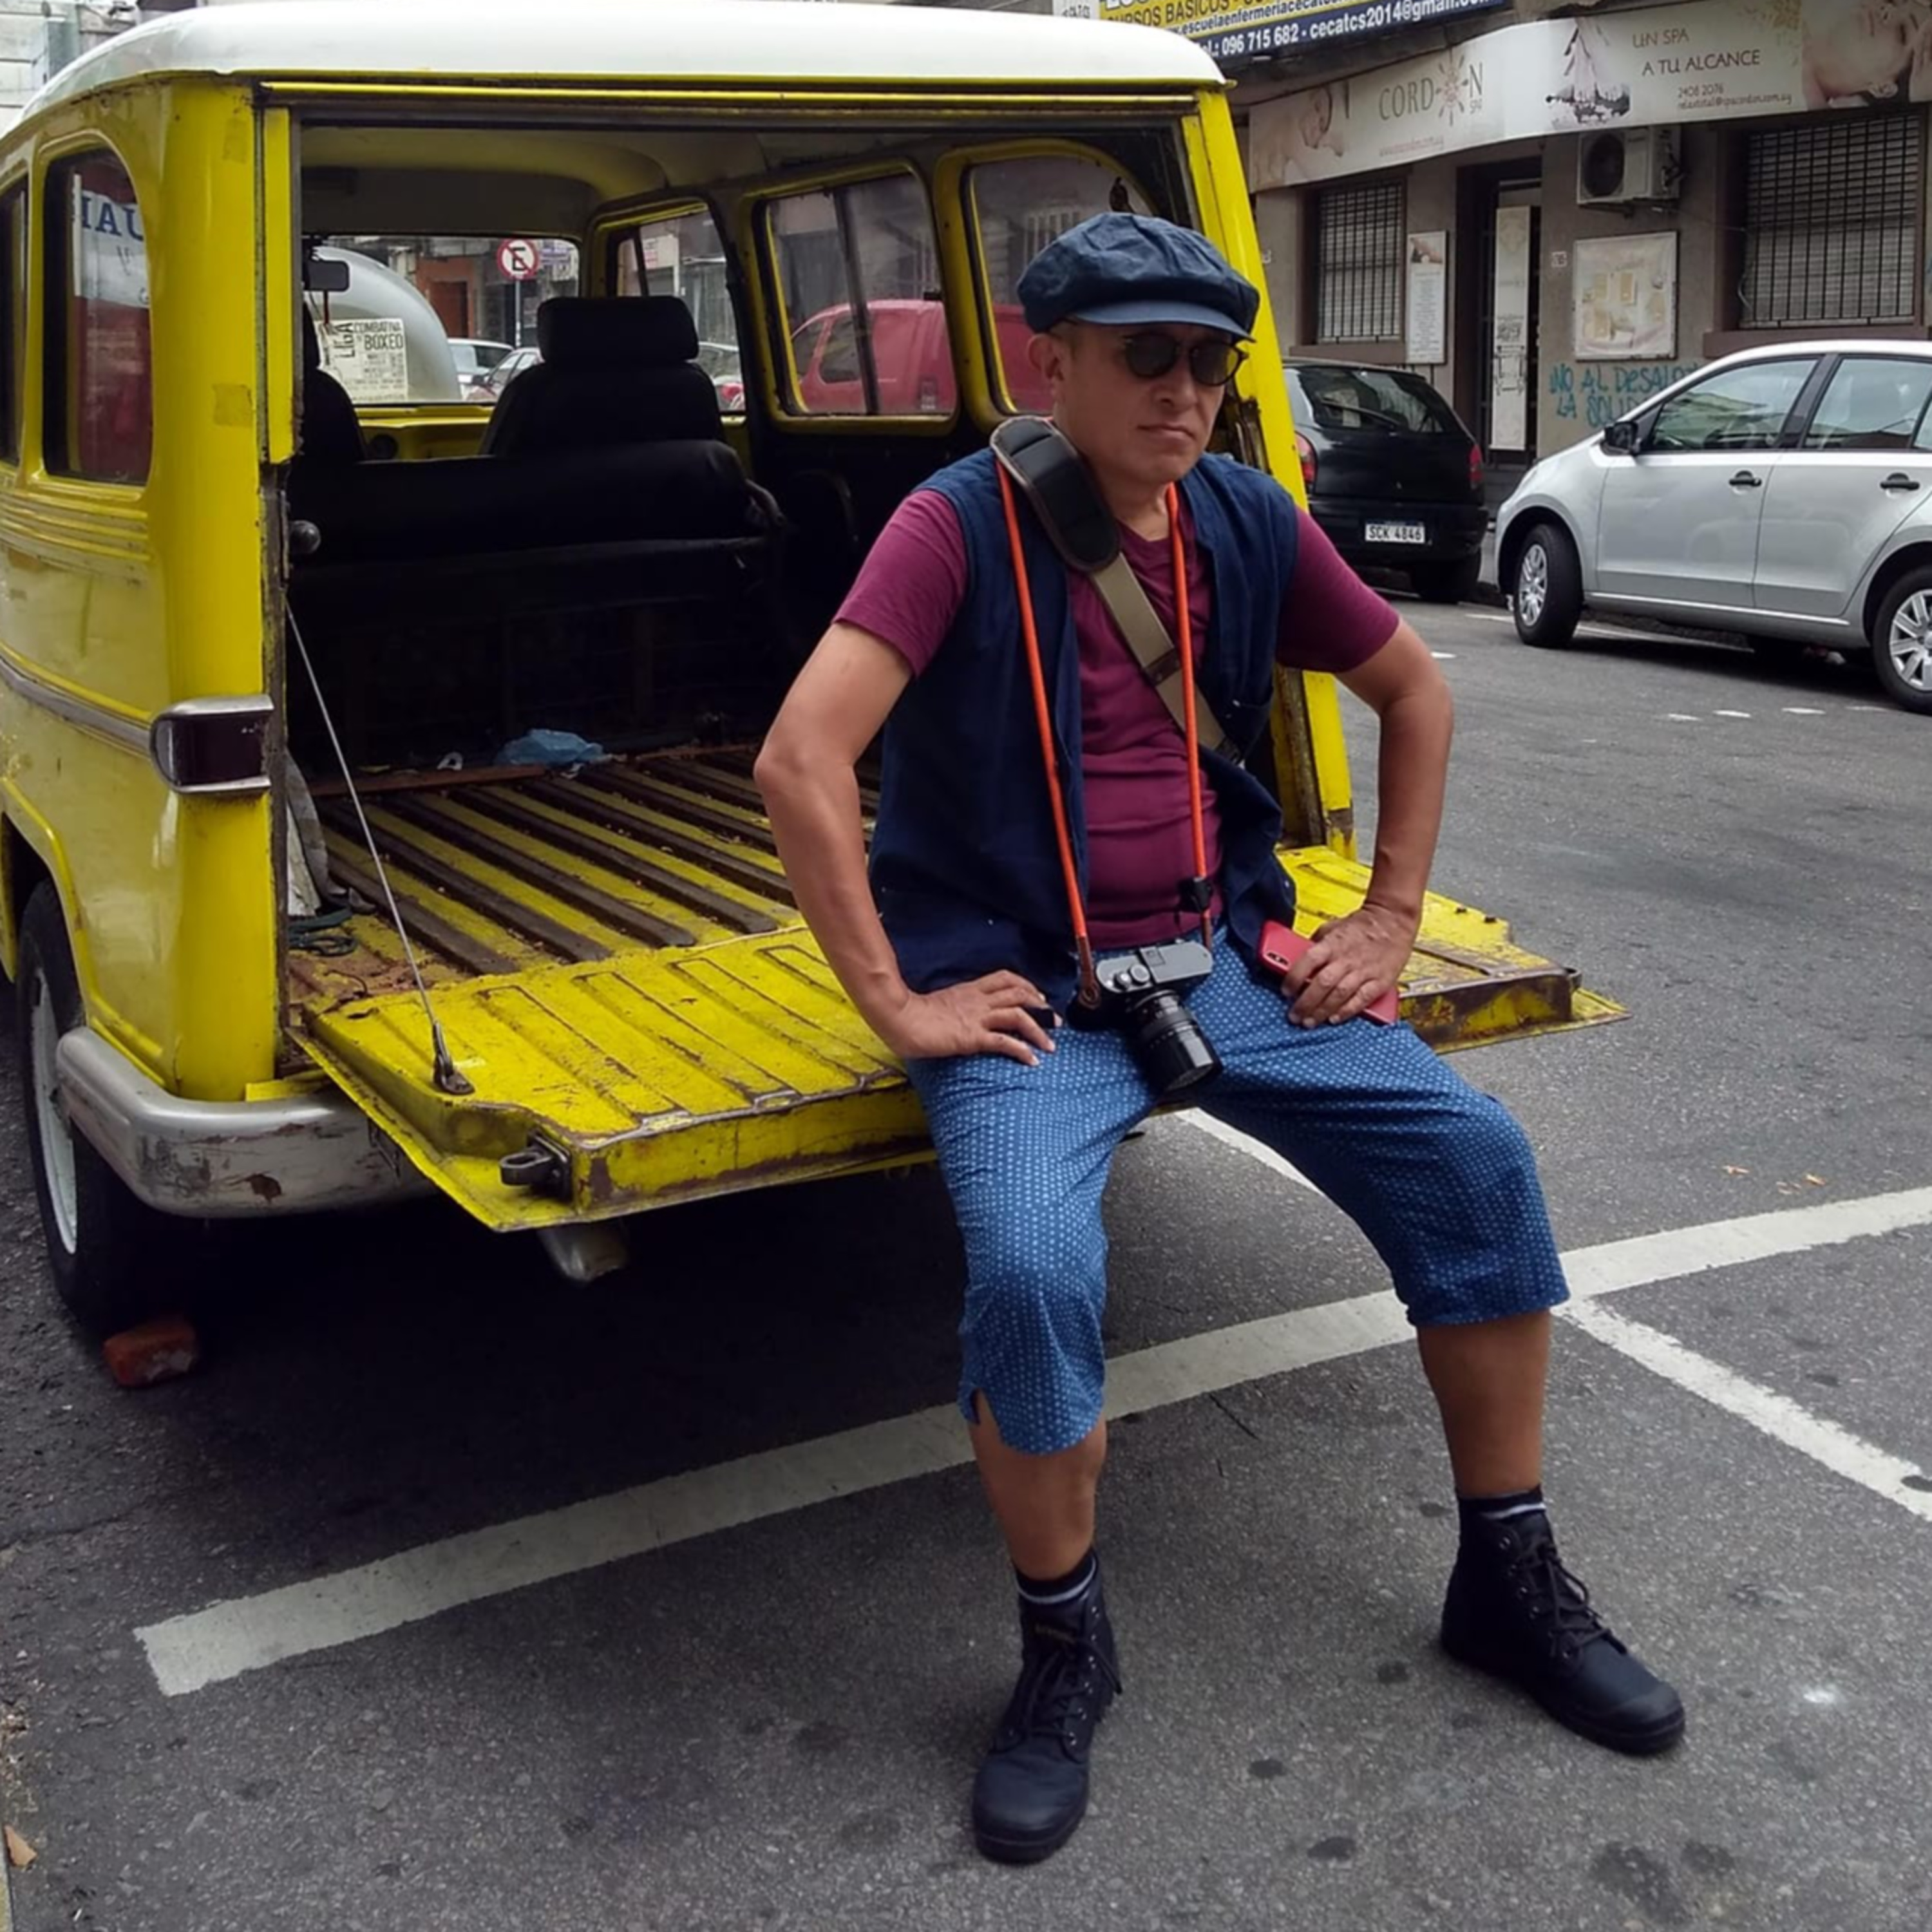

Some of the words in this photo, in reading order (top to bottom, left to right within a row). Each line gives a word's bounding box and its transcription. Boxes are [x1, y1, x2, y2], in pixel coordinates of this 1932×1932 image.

[1222, 34, 1245, 55] 096
[1247, 28, 1271, 51] 715
[1274, 23, 1299, 46] 682
[1663, 28, 1689, 45] SPA
[1642, 62, 1654, 76] A
[1658, 59, 1680, 75] TU
[1685, 50, 1761, 72] ALCANCE
[365, 334, 404, 350] BOXEO
[1368, 526, 1390, 539] SCK
